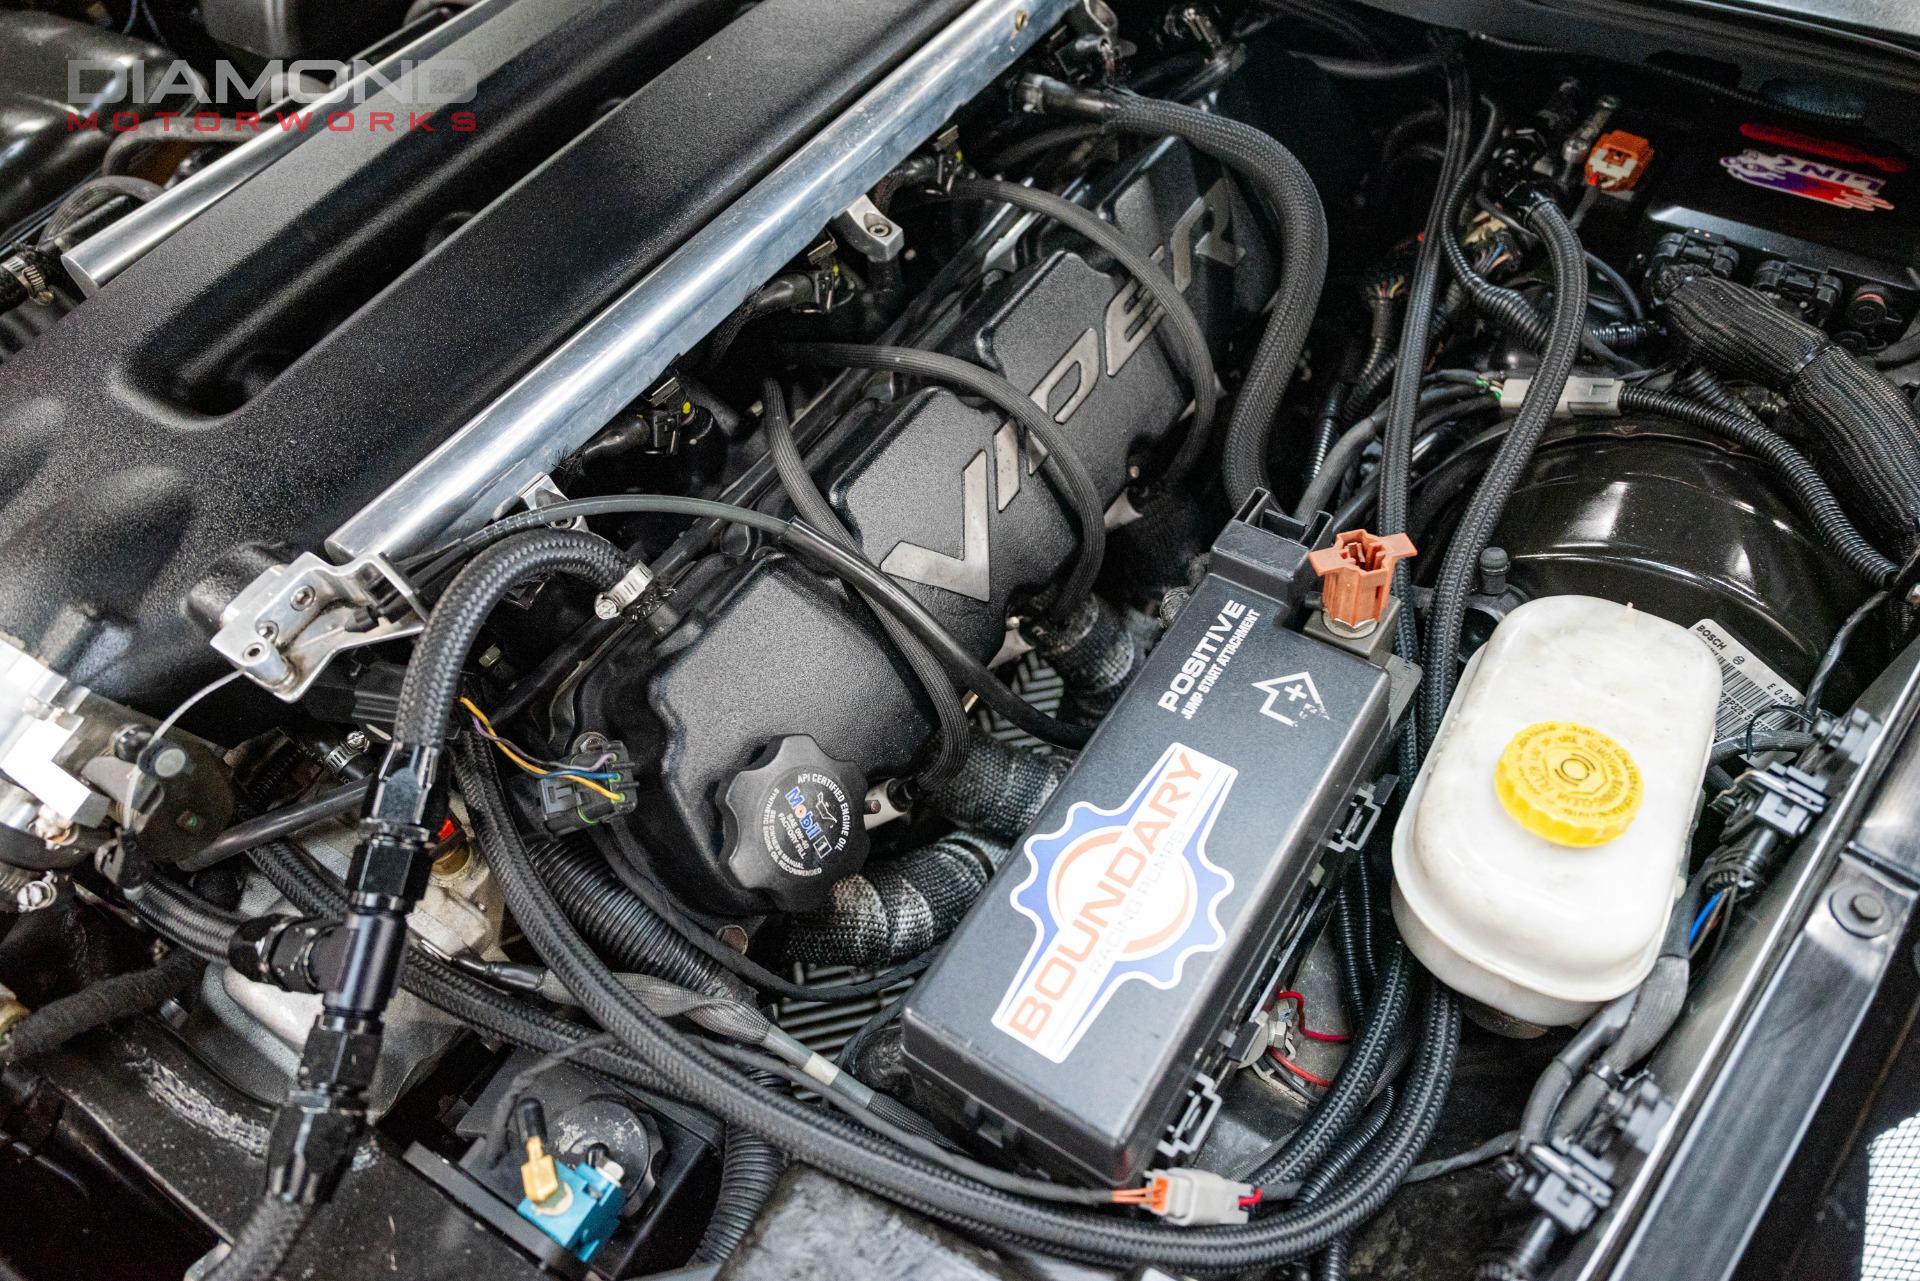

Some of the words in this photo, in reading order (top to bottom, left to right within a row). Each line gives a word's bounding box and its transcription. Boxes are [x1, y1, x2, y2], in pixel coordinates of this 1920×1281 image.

[1696, 624, 1728, 651] BOSCH
[1157, 599, 1246, 713] POSITIVE
[1181, 691, 1204, 720] JUMP
[1197, 663, 1223, 694] START
[1216, 608, 1261, 667] ATTACHMENT
[797, 773, 810, 784] API
[812, 773, 845, 802] CERTIFIED
[785, 786, 822, 840] Mobil
[840, 802, 850, 837] ENGINE
[777, 812, 797, 845] FACTORY
[795, 842, 807, 860] FILL
[834, 837, 847, 851] OIL
[778, 859, 822, 877] RECOMMENDED
[781, 851, 804, 870] MANUAL
[1008, 752, 1202, 1041] BOUNDARY
[1089, 897, 1142, 975] RACING
[1141, 829, 1186, 896] PUMPS
